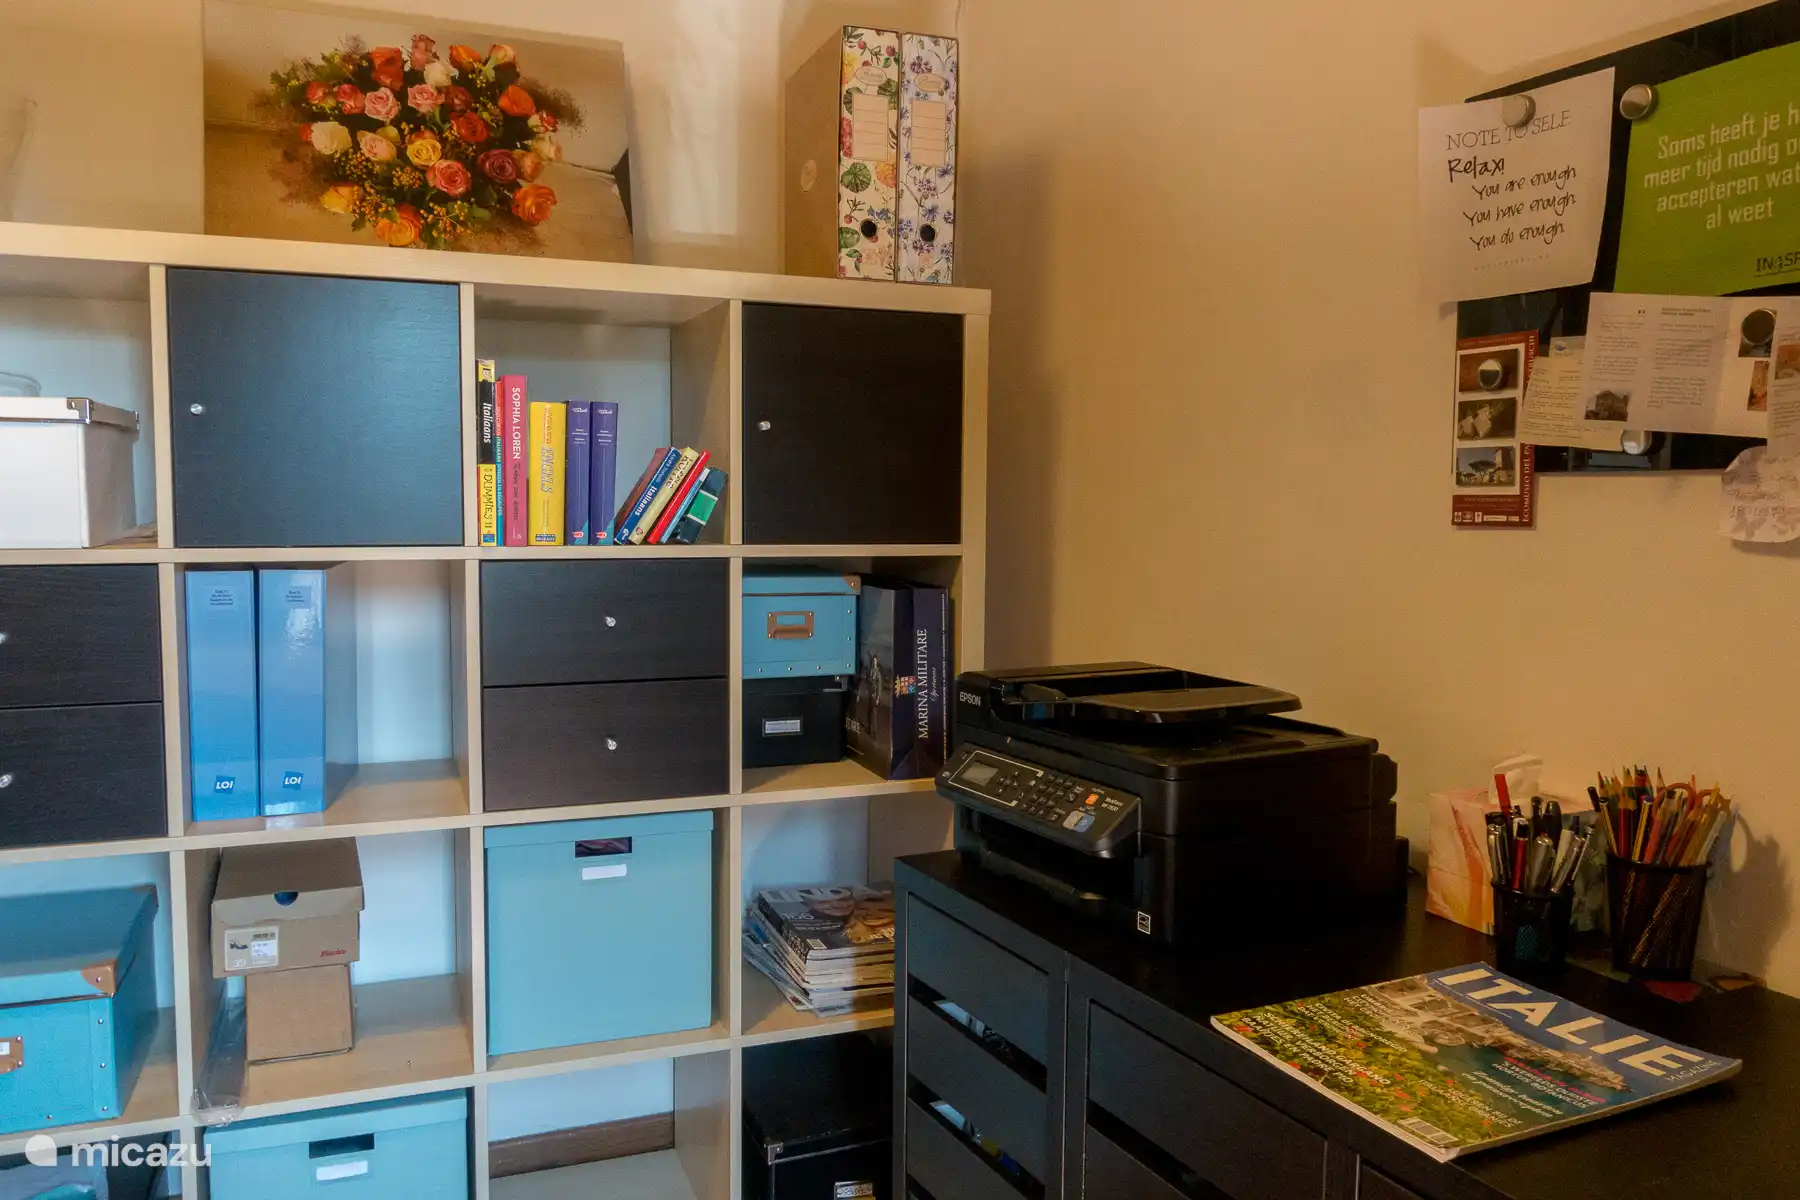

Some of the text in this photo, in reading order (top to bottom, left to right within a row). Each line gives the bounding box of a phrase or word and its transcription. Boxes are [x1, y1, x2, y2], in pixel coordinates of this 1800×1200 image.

[1446, 127, 1500, 150] NOTE
[1532, 110, 1570, 135] SELF
[1658, 134, 1705, 159] Soms
[1710, 112, 1755, 146] heeft
[1762, 111, 1780, 138] je
[1644, 164, 1690, 189] meer
[1696, 146, 1722, 180] tijd
[1728, 138, 1779, 169] nodig
[1472, 165, 1576, 200] You are enough
[1657, 174, 1758, 212] accepteren
[1463, 192, 1576, 226] You have enough
[1706, 197, 1774, 230] al weet
[1470, 221, 1564, 251] You do enough
[483, 402, 493, 444] Italiaans
[512, 387, 521, 459] SOPHIA LOREN
[634, 485, 659, 517] Italiaans
[916, 628, 929, 739] MARINA MILITARE
[959, 691, 982, 706] EPSON
[216, 780, 233, 790] LOI
[284, 776, 301, 786] LOI
[1437, 967, 1705, 1078] ITALIE
[1263, 1012, 1337, 1055] SCHIEREILAND
[1335, 1054, 1391, 1085] GARGANO
[1295, 1041, 1356, 1075] VERBORGEN
[1299, 1052, 1335, 1072] PADRE
[1332, 1071, 1354, 1083] PIO
